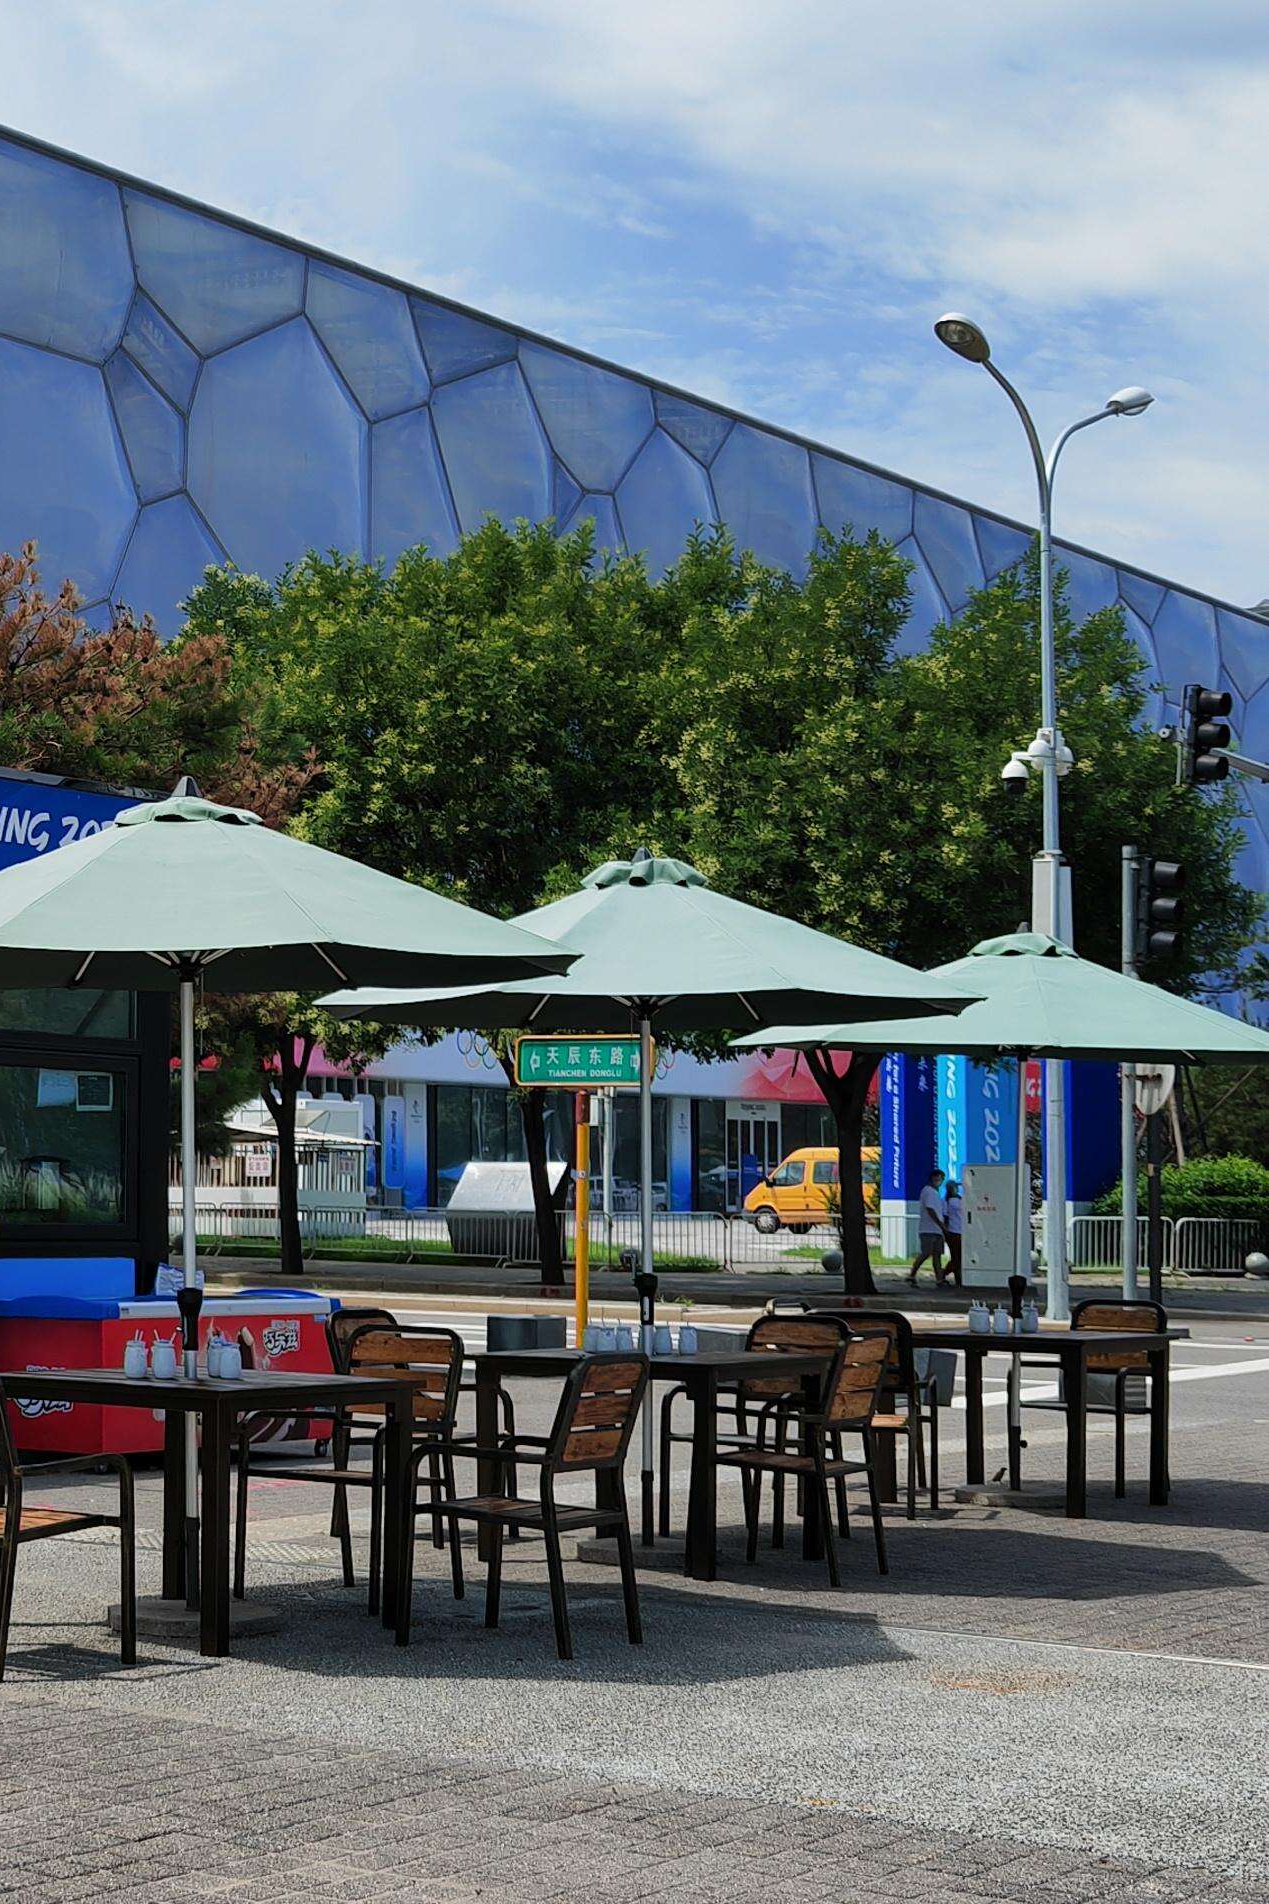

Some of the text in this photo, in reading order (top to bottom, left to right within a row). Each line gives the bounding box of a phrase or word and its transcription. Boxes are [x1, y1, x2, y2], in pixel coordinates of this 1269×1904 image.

[59, 816, 116, 847] 20
[546, 1046, 624, 1065] 天辰东路
[547, 1068, 622, 1078] TIANCHEN DONGLU
[984, 1108, 1002, 1164] 202
